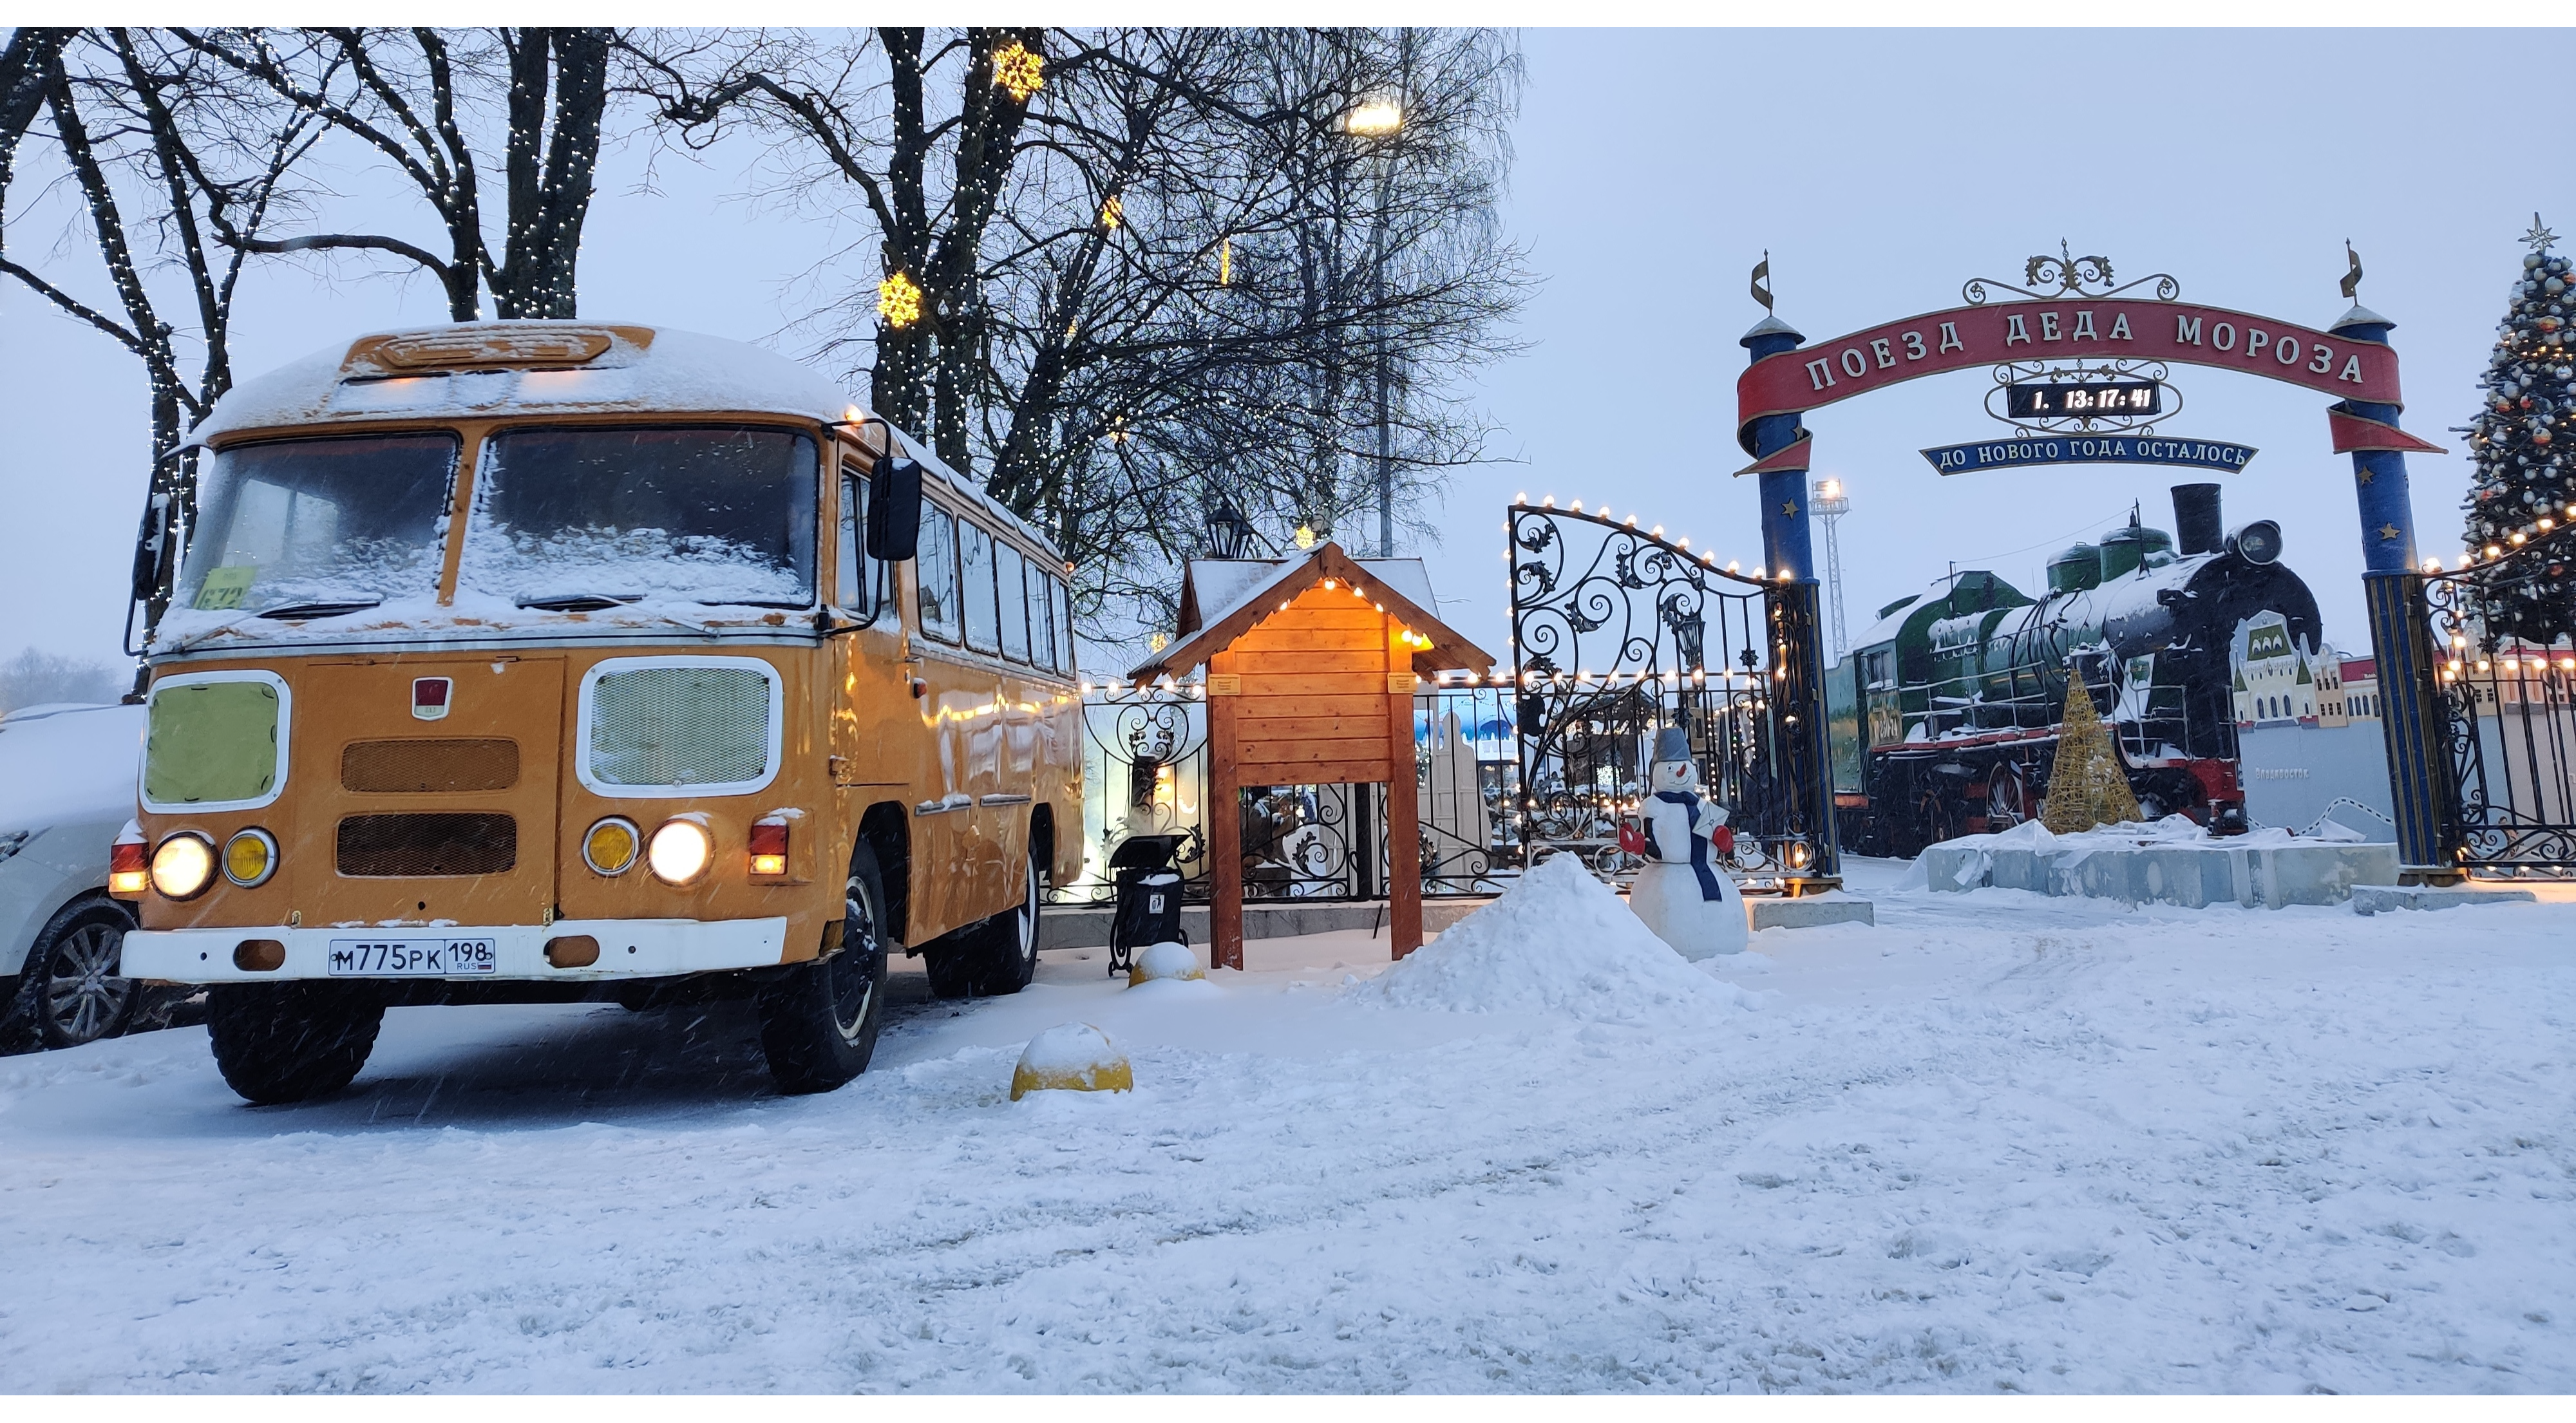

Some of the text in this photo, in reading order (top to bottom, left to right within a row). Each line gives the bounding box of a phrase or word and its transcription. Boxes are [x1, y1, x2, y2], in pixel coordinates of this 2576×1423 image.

[1804, 310, 2364, 391] ПОЕЗД ДЕДА МОРОЗА
[2033, 390, 2050, 410] 1.
[1939, 438, 2246, 470] ДО НОВОГО ГОДА ОСТАЛОСЬ
[448, 942, 487, 963] 198
[457, 962, 477, 970] RUS
